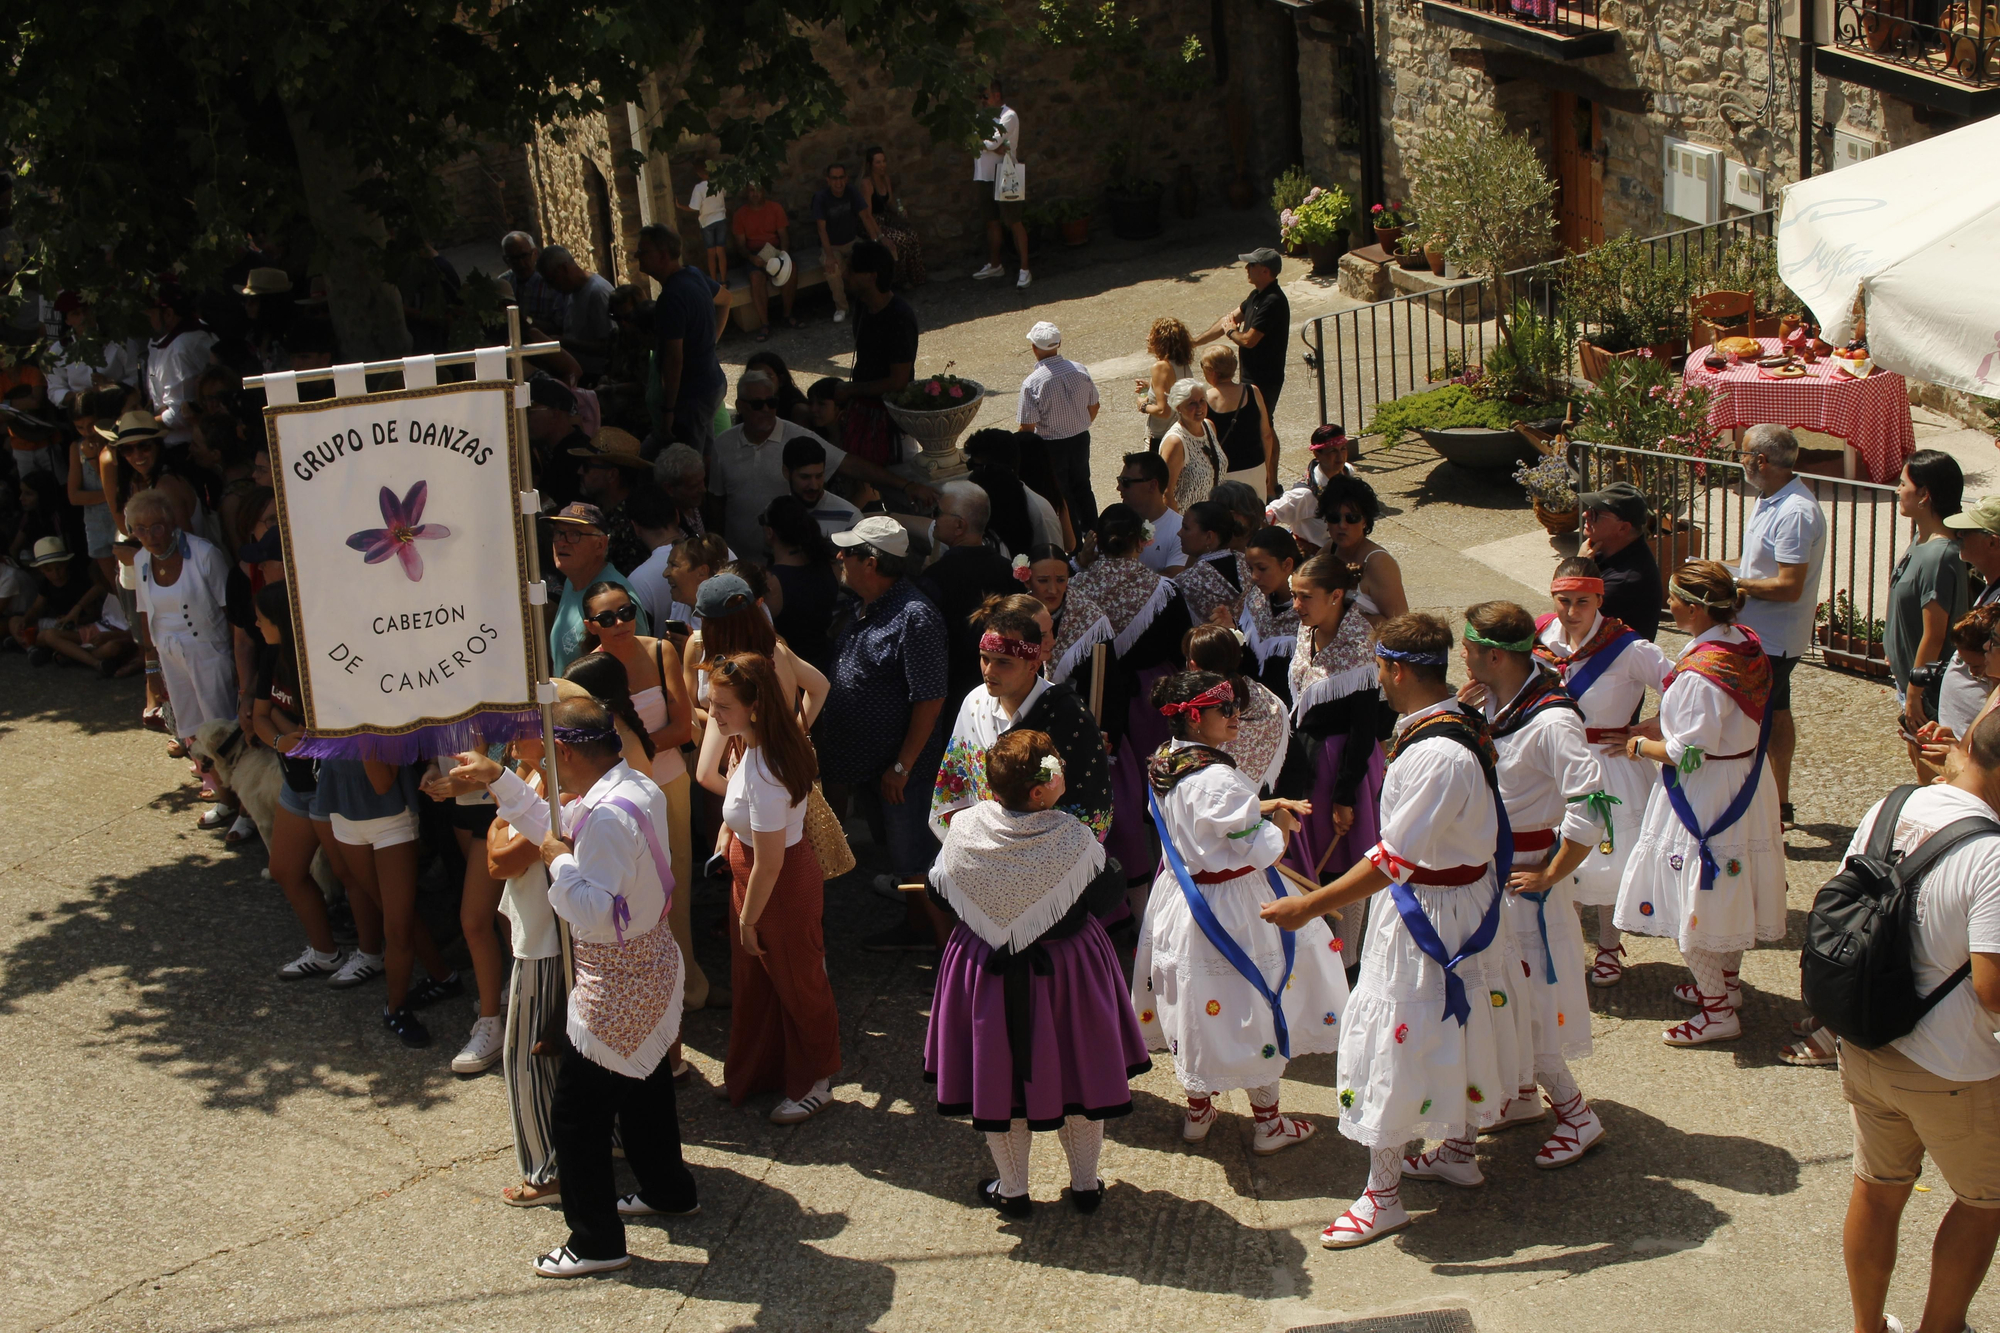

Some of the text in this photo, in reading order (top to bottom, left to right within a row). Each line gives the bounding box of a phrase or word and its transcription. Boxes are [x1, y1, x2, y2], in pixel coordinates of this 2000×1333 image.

[293, 419, 494, 482] GRUPO DE DANZAS
[372, 603, 465, 635] CABEZÓN
[327, 623, 498, 694] DE CAMEROS
